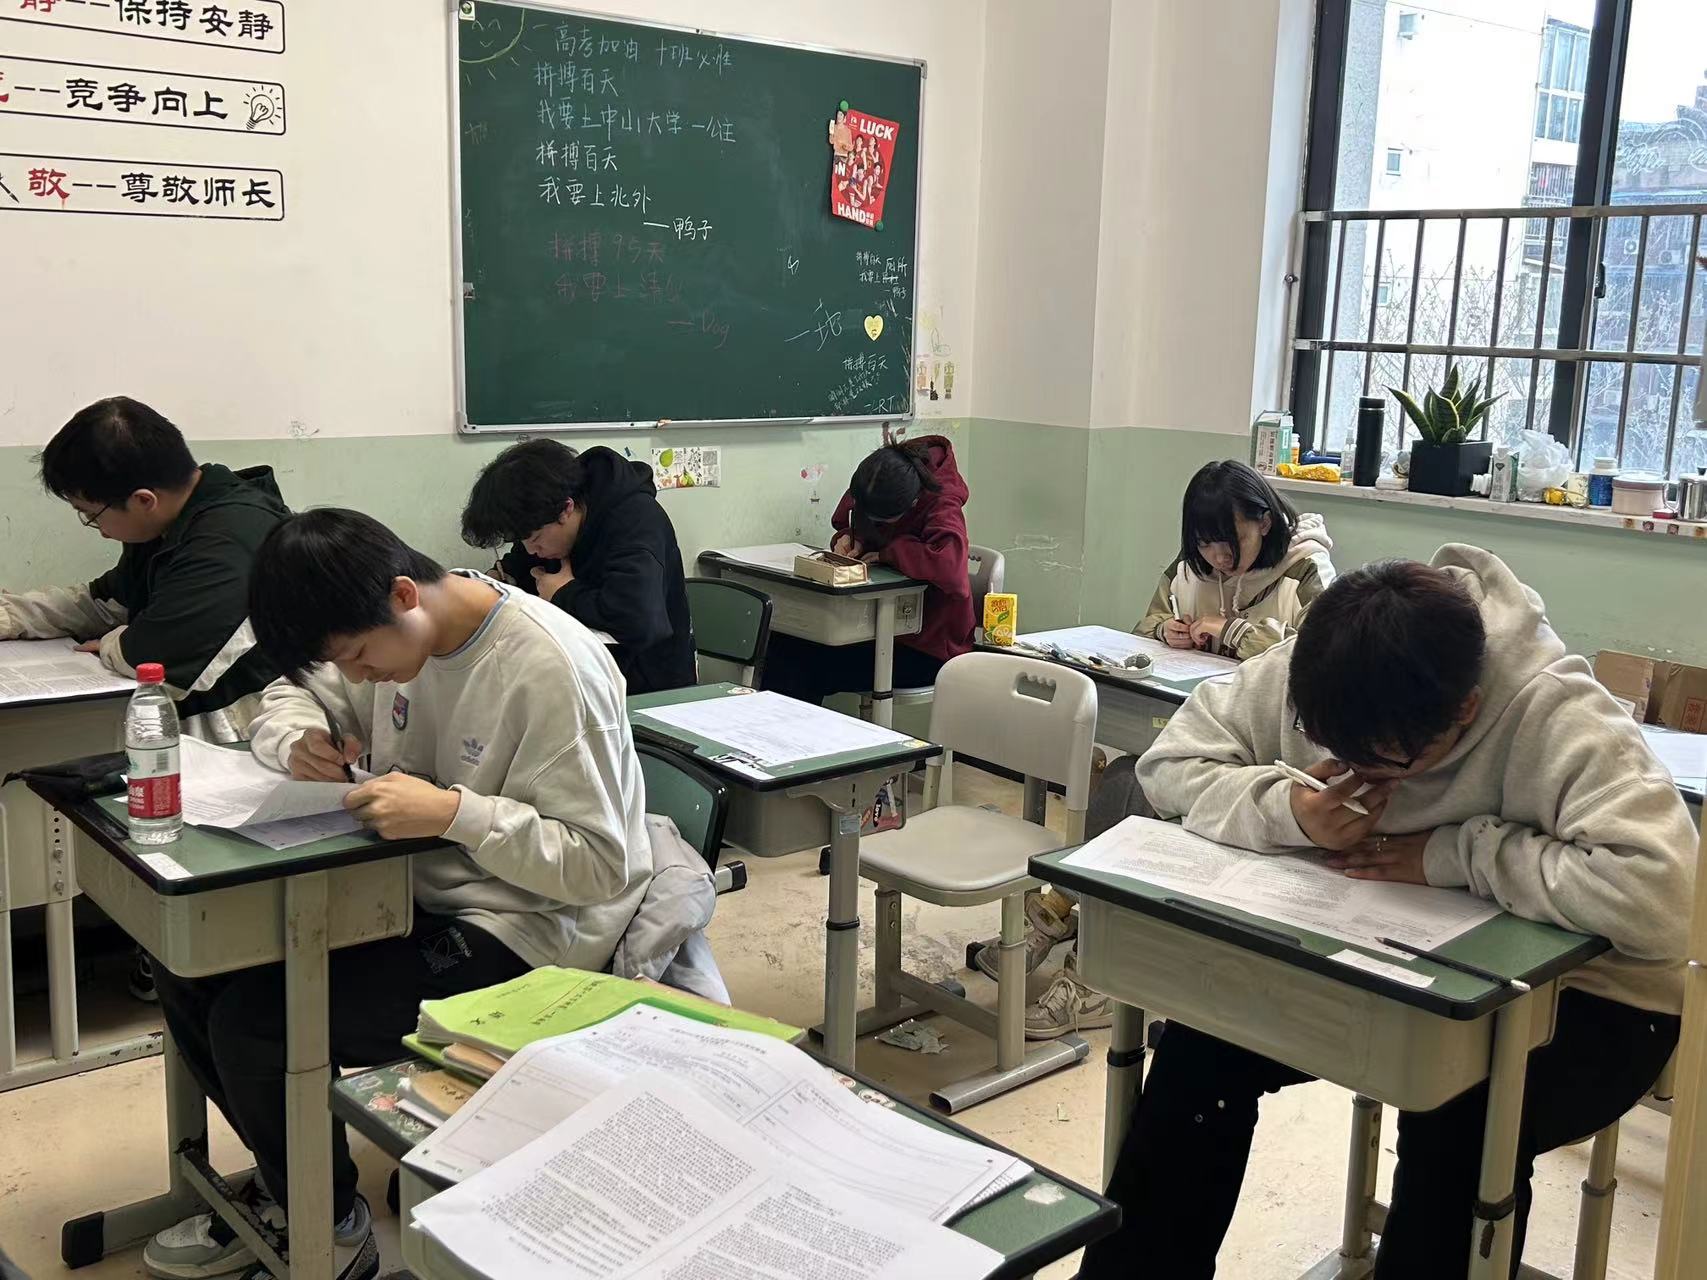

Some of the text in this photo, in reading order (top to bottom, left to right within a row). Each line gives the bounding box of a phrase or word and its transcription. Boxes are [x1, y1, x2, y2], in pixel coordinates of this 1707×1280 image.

[533, 61, 620, 97] 拼搏百天
[859, 118, 895, 141] LUCK
[536, 140, 619, 172] 拼搏百天
[837, 201, 866, 224] HAND
